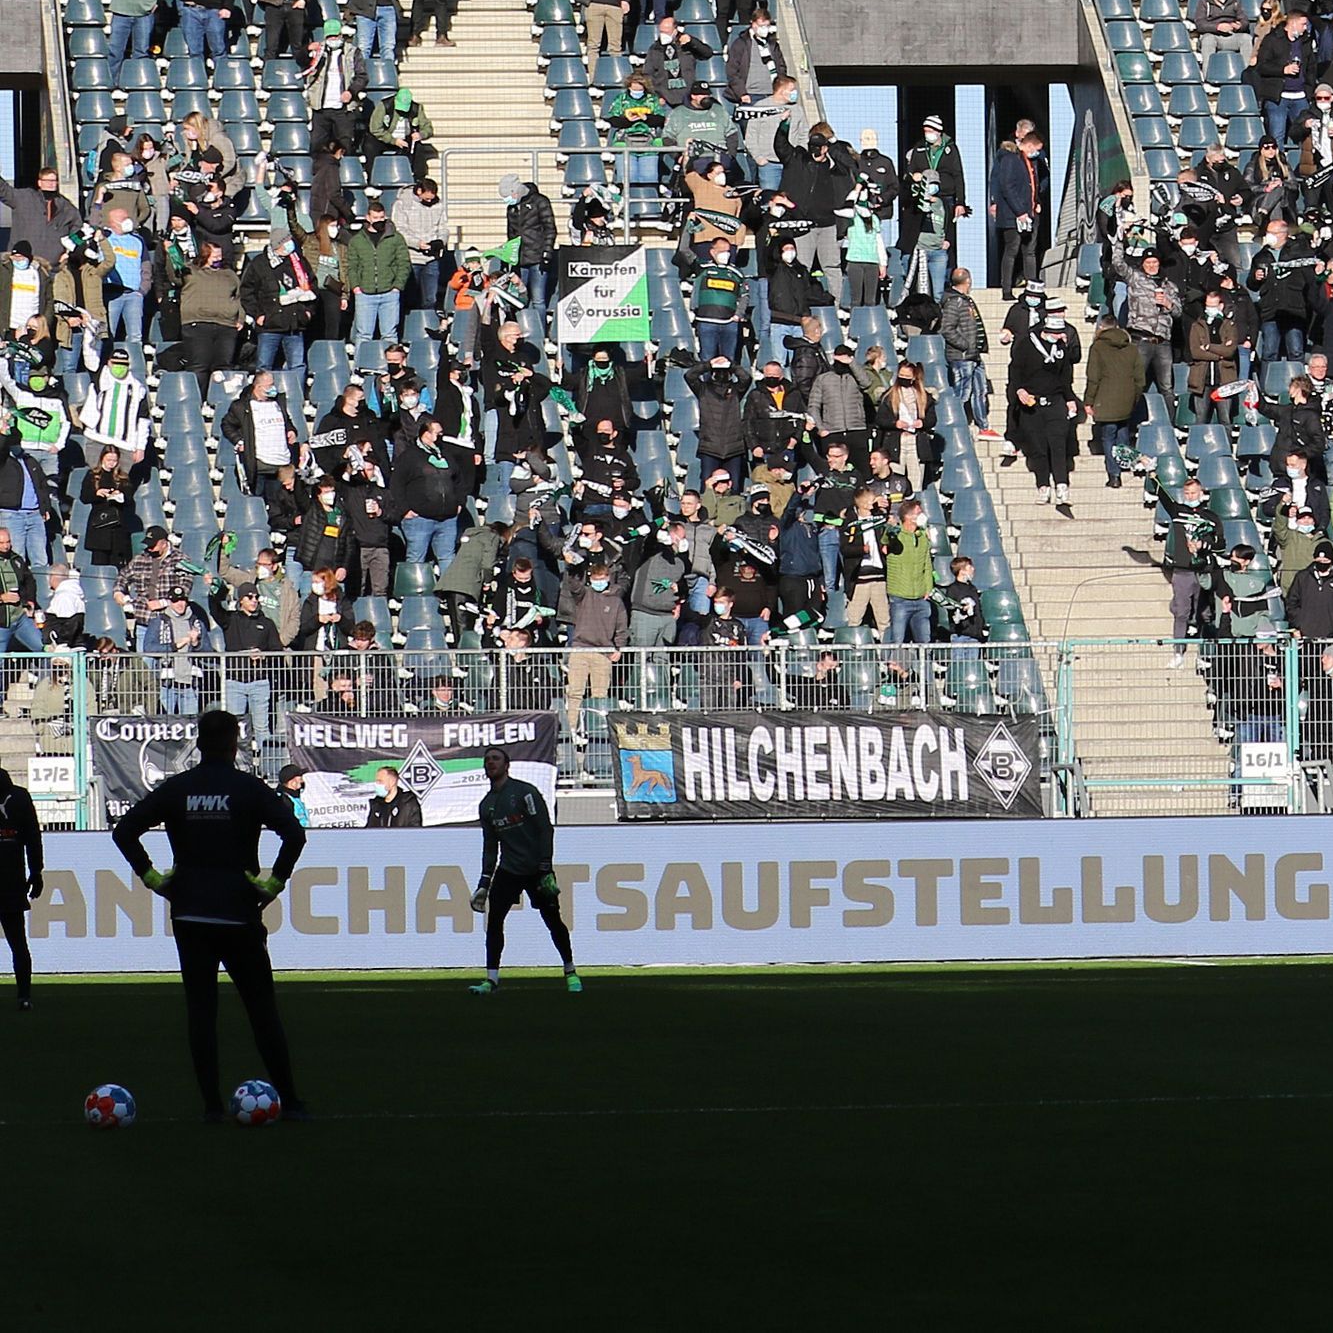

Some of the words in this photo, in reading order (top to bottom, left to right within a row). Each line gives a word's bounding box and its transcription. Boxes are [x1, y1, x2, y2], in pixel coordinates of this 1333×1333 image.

[569, 262, 637, 279] Kämpfen
[593, 285, 616, 298] für
[294, 723, 409, 749] HELLWEG
[443, 722, 536, 748] FOHLEN
[682, 723, 970, 803] HILCHENBACH
[1245, 753, 1283, 768] 16/1
[32, 767, 70, 782] 17/2
[186, 794, 230, 812] WWK
[308, 803, 368, 817] PADERBORN
